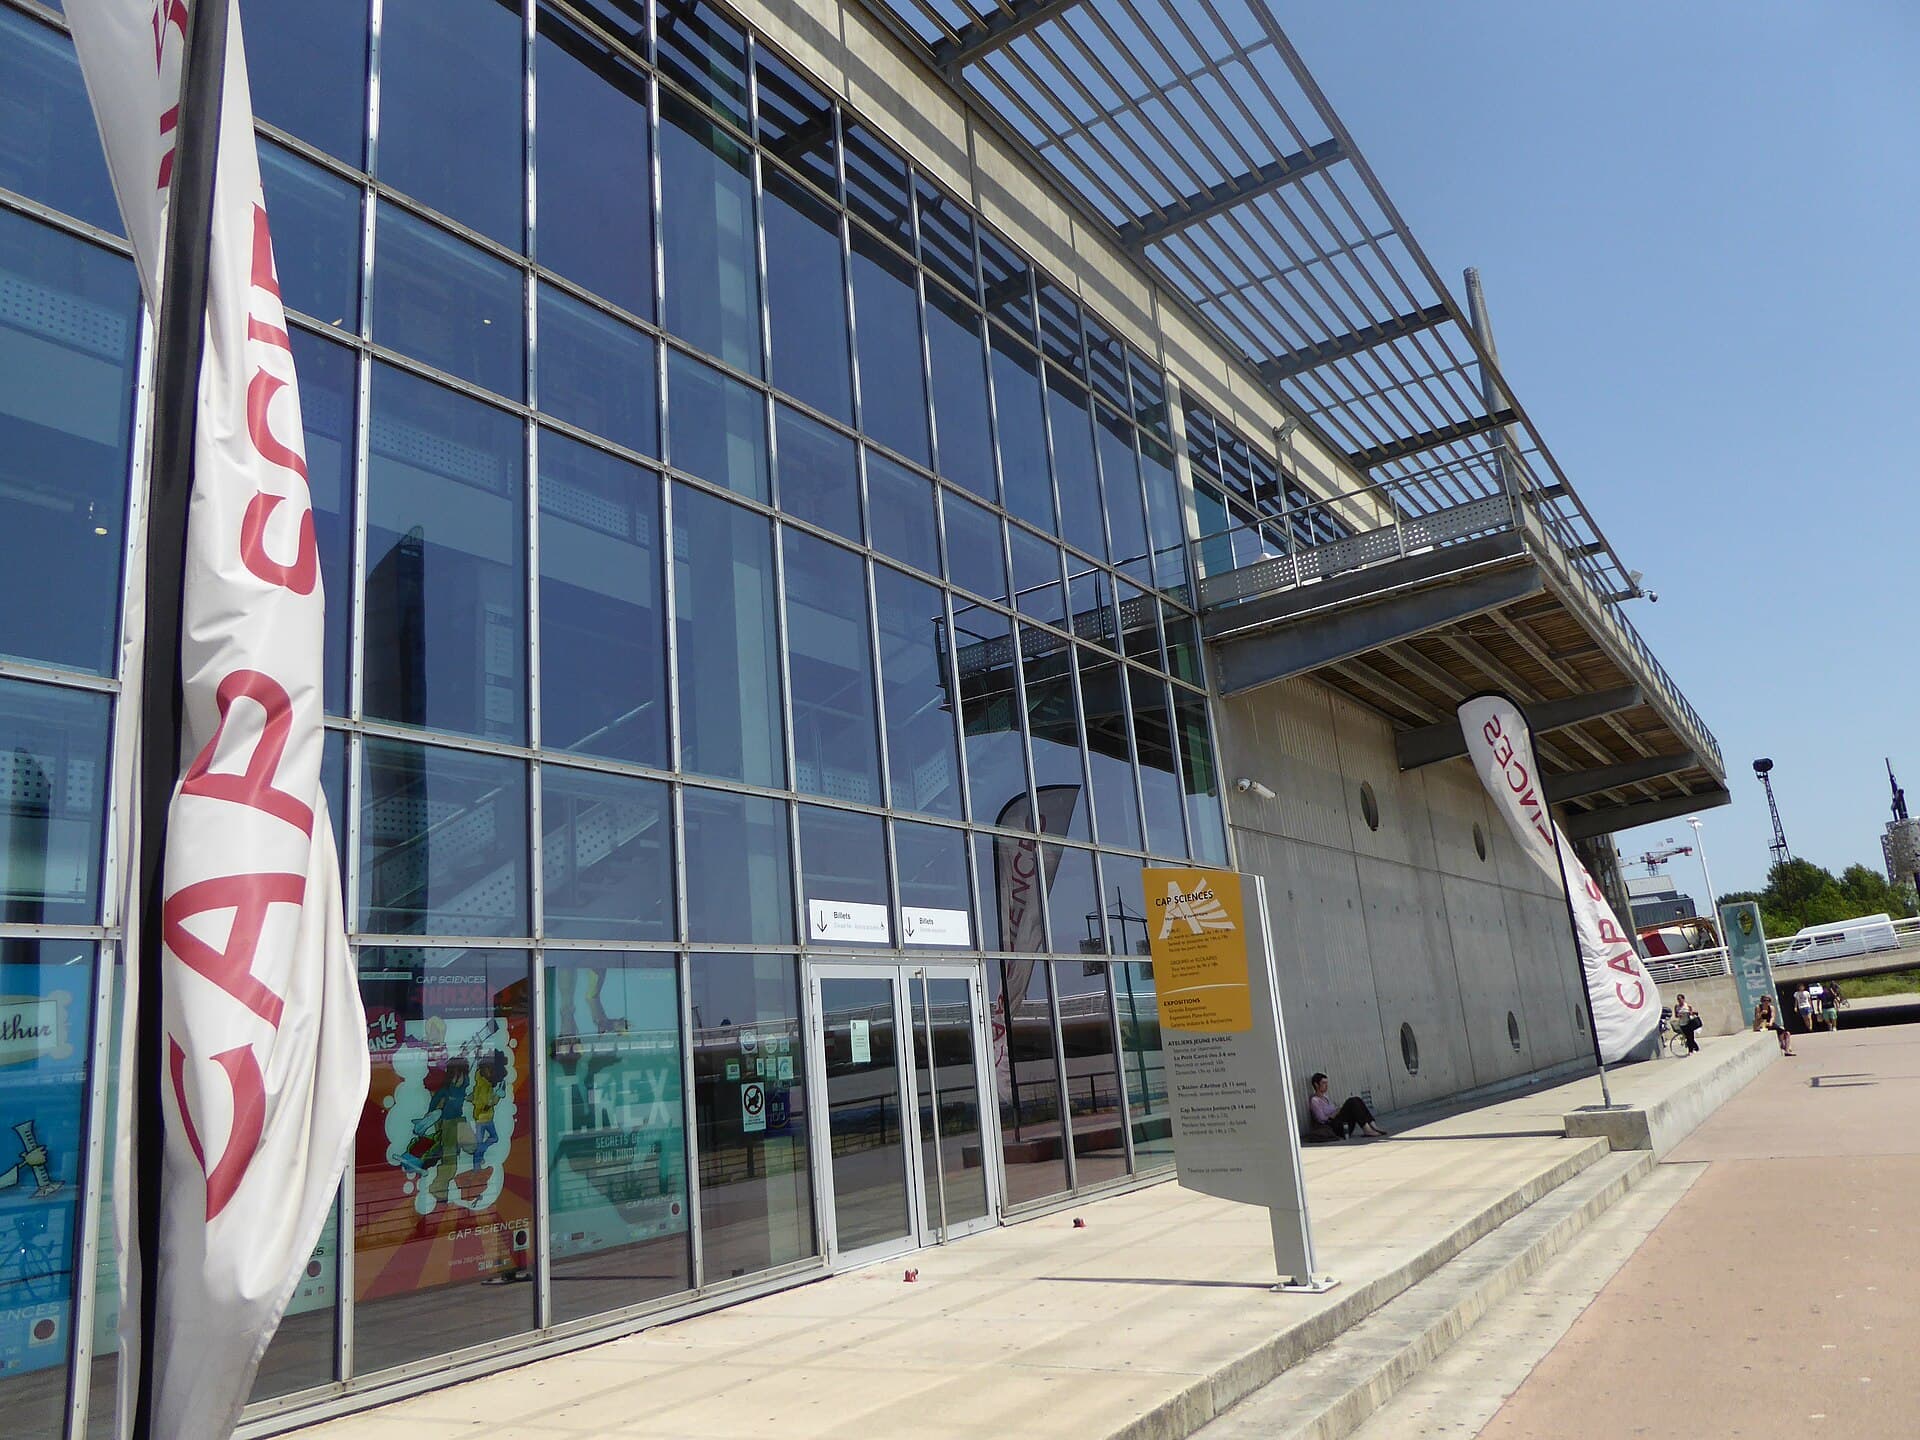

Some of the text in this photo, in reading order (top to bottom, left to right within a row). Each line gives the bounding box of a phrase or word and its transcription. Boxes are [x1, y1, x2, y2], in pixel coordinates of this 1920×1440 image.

[1155, 891, 1213, 906] CAP SCIENCES
[833, 911, 851, 920] Billets
[919, 917, 934, 925] Billets
[163, 669, 315, 1224] CAP
[1599, 918, 1646, 1010] CAP
[416, 975, 486, 985] CAP SCIENCES
[1163, 998, 1200, 1006] EXPOSITIONS
[0, 1013, 52, 1041] thur
[368, 1033, 398, 1051] ANS
[1168, 1039, 1192, 1047] ATELIERS
[1193, 1038, 1210, 1046] JEUNE
[595, 1135, 629, 1149] SECRETS
[447, 1218, 529, 1241] CAP SCIENCES
